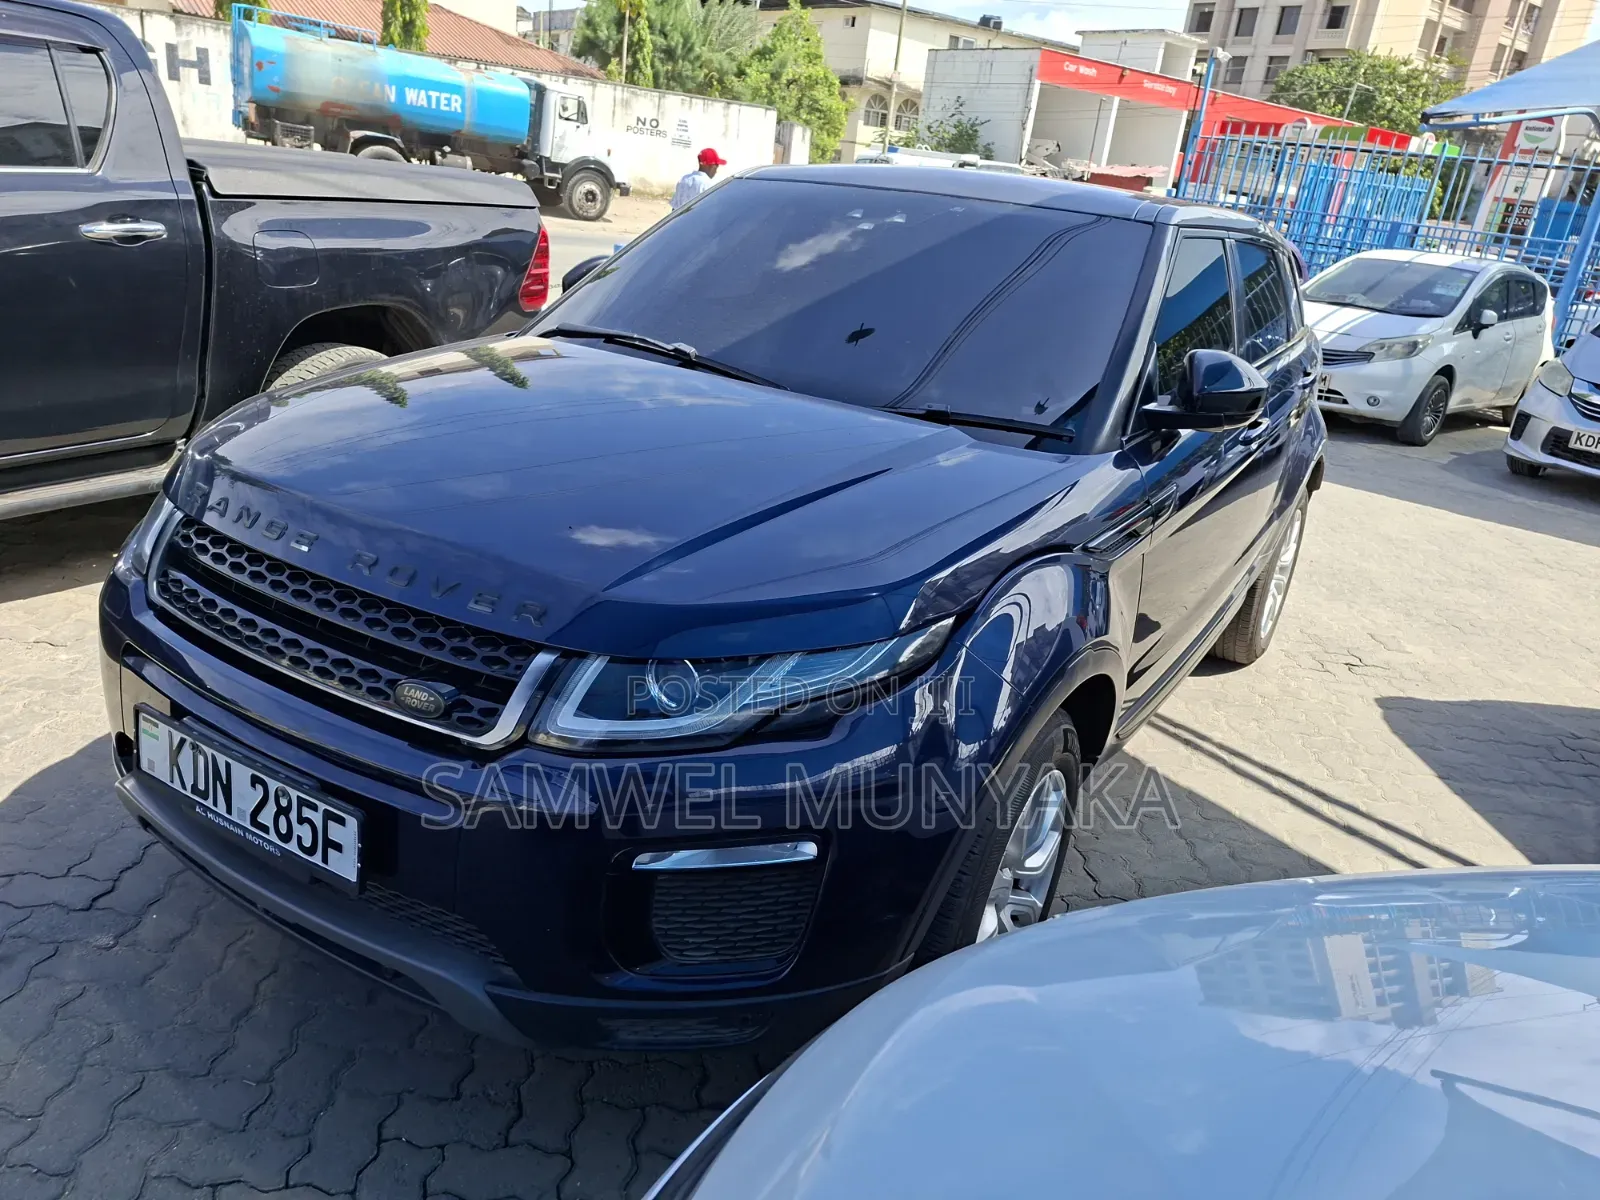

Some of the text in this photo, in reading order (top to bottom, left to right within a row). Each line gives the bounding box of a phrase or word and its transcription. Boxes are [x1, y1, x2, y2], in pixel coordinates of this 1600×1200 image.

[1063, 61, 1097, 77] Car Wash
[404, 86, 462, 113] WATER
[636, 115, 660, 129] NO
[625, 125, 668, 138] POSTERS
[187, 481, 548, 628] RANGE ROVER
[403, 686, 429, 702] LAND
[404, 697, 436, 713] ROVER
[167, 729, 233, 816] KDN
[249, 772, 347, 866] 285F
[195, 805, 281, 857] AL HUSNAIN MOTORS
